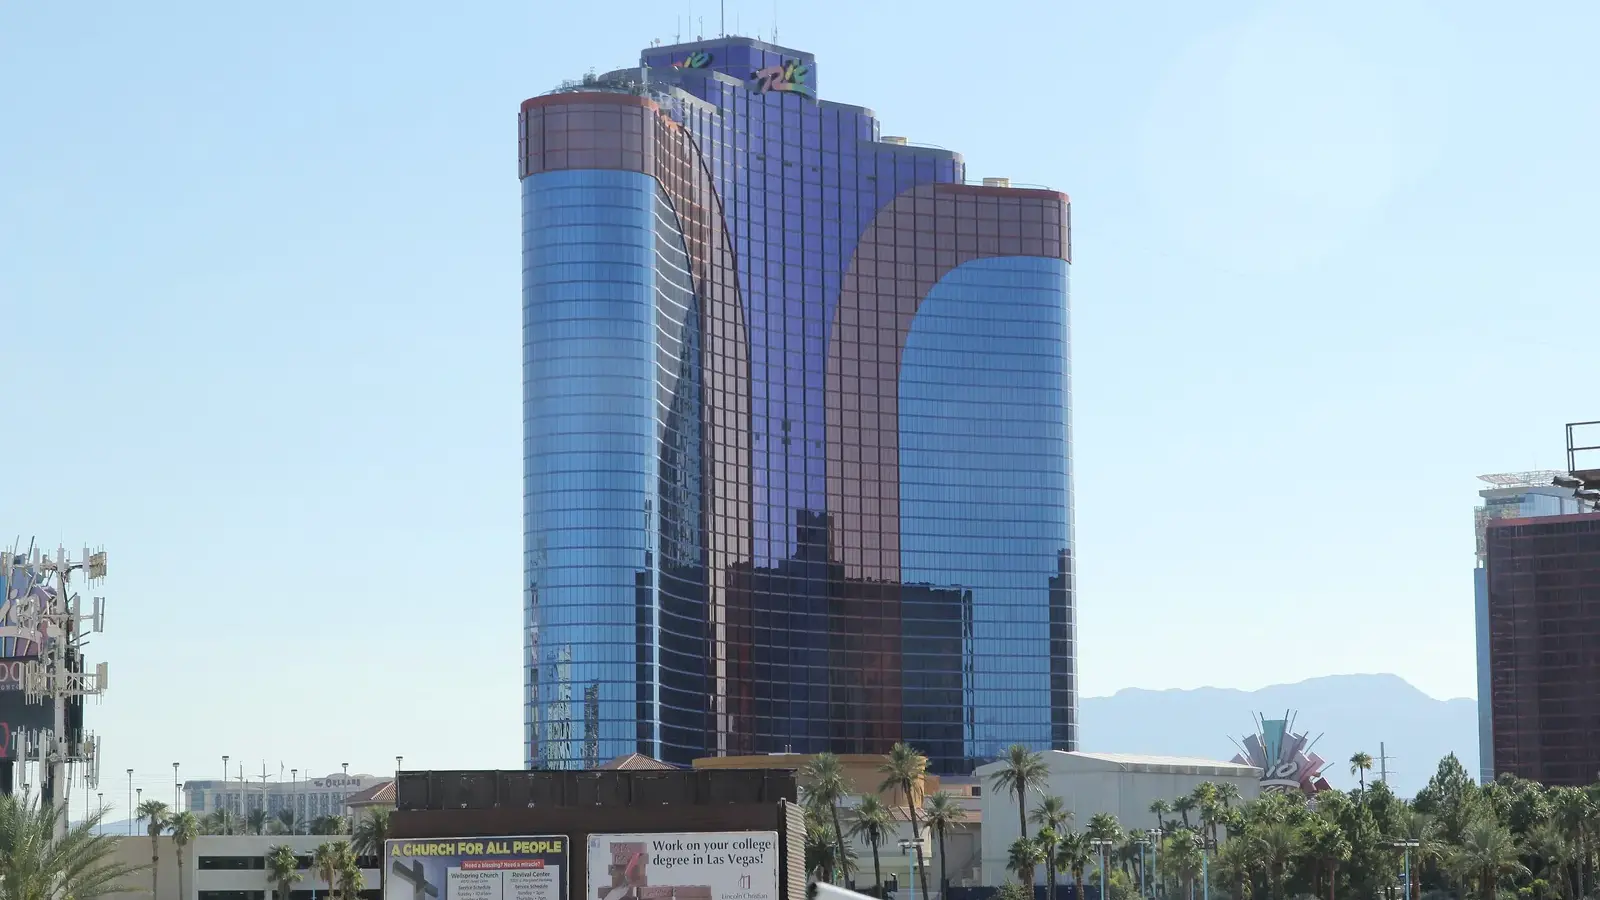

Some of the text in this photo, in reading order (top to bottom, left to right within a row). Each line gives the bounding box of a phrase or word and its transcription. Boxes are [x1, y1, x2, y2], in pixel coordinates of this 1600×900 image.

[391, 840, 562, 857] A CHURCH FOR ALL PEOPLE
[652, 837, 771, 853] Work on your college
[481, 861, 503, 869] blessing?
[652, 853, 764, 868] degree in Las Vegas!
[743, 892, 768, 900] Christian
